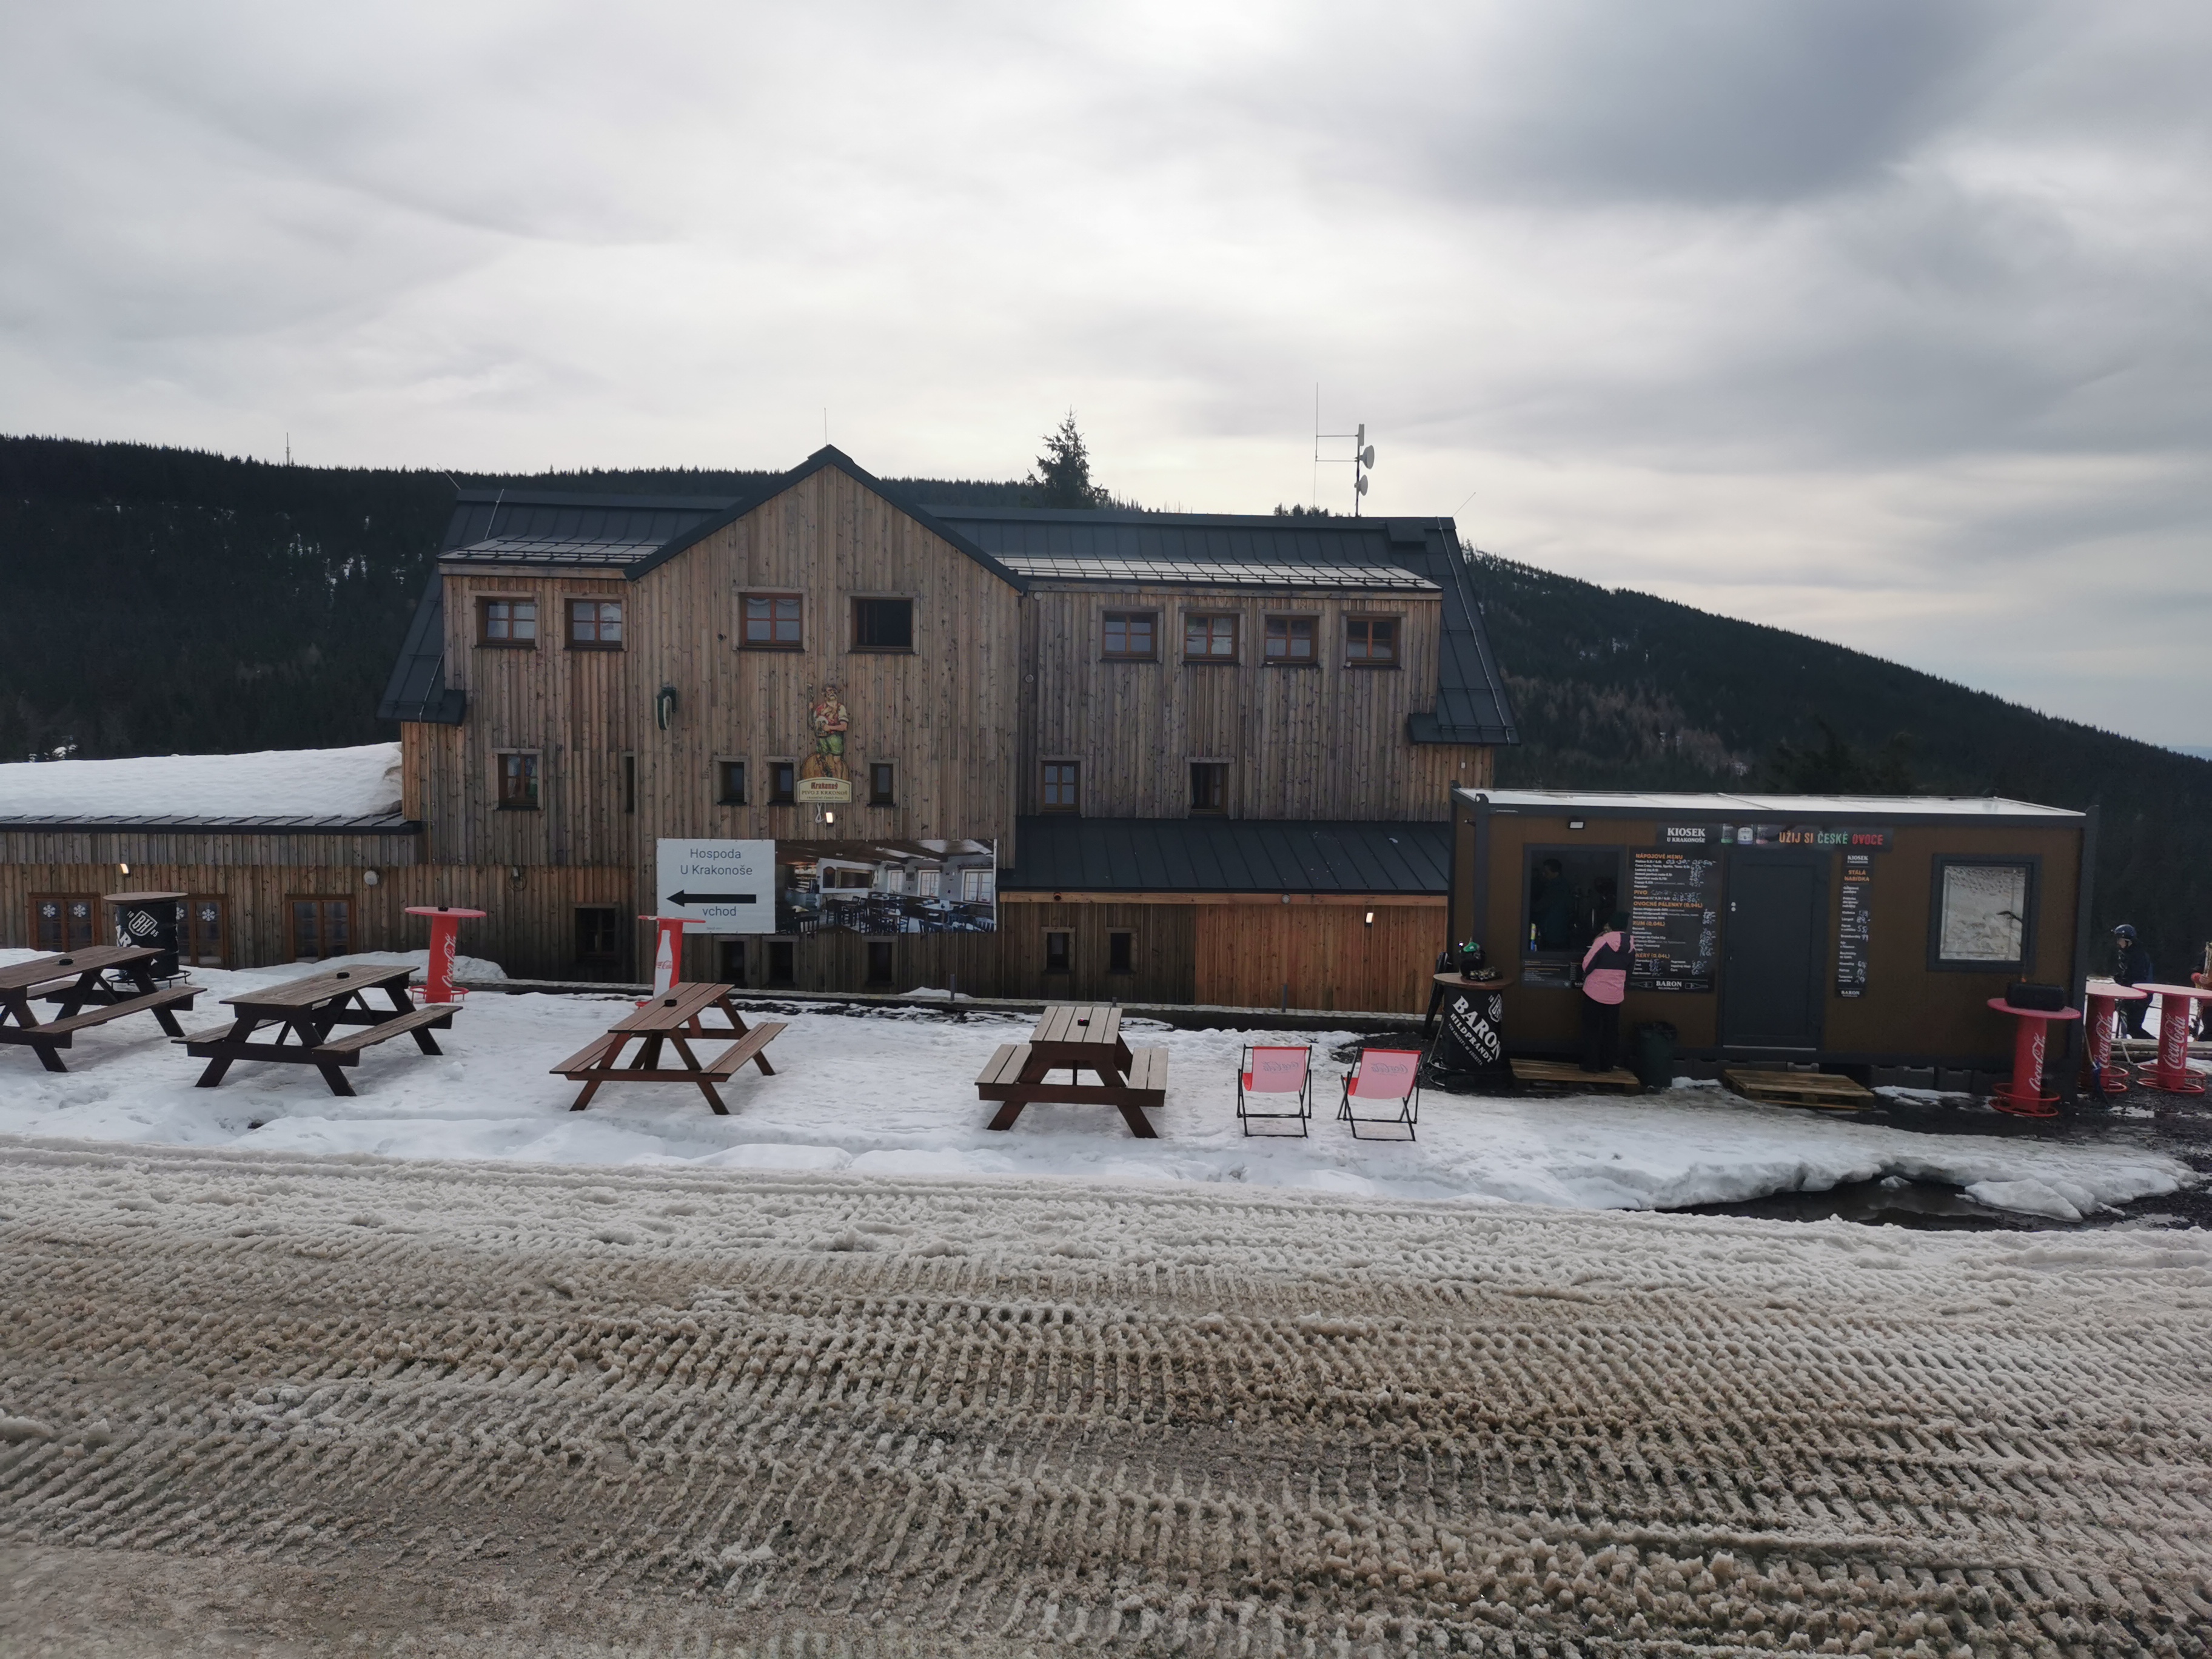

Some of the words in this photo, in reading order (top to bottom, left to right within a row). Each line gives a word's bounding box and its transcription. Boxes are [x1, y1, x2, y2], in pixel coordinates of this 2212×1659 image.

[1667, 827, 1706, 837] KIOSEK
[1778, 830, 1801, 843] UŽIJ
[1804, 833, 1814, 843] SI
[1817, 830, 1848, 845] ČESKÉ
[1852, 834, 1883, 845] OVOCE
[690, 848, 742, 860] Hospoda
[680, 865, 688, 874] U
[692, 864, 752, 875] Krakonoše
[702, 906, 736, 916] vchod
[1452, 994, 1502, 1062] BARON
[1450, 1012, 1493, 1064] HILDPRANDT
